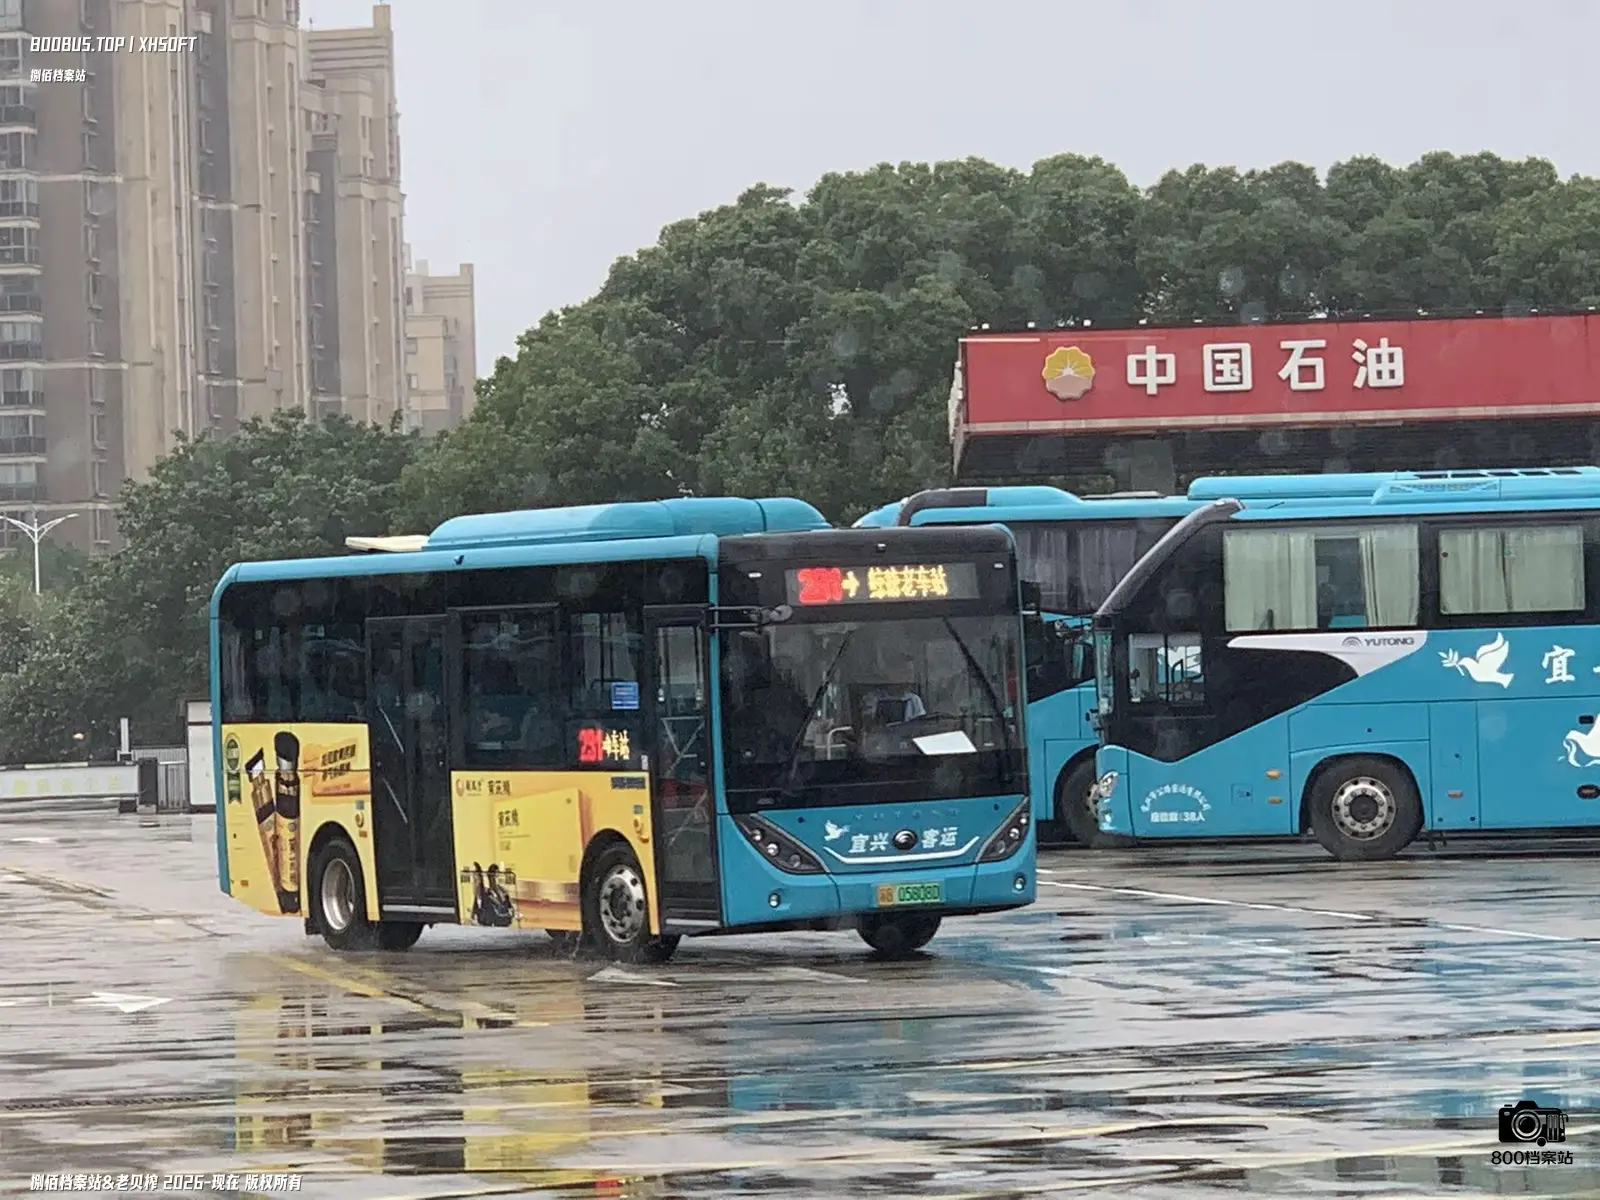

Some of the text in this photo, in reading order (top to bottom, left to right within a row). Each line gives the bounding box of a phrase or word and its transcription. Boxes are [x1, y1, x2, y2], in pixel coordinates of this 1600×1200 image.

[1126, 336, 1406, 396] 中国石油
[1363, 636, 1415, 647] YUTONG
[1541, 644, 1600, 685] 宜
[848, 826, 958, 853] 宜兴 客运
